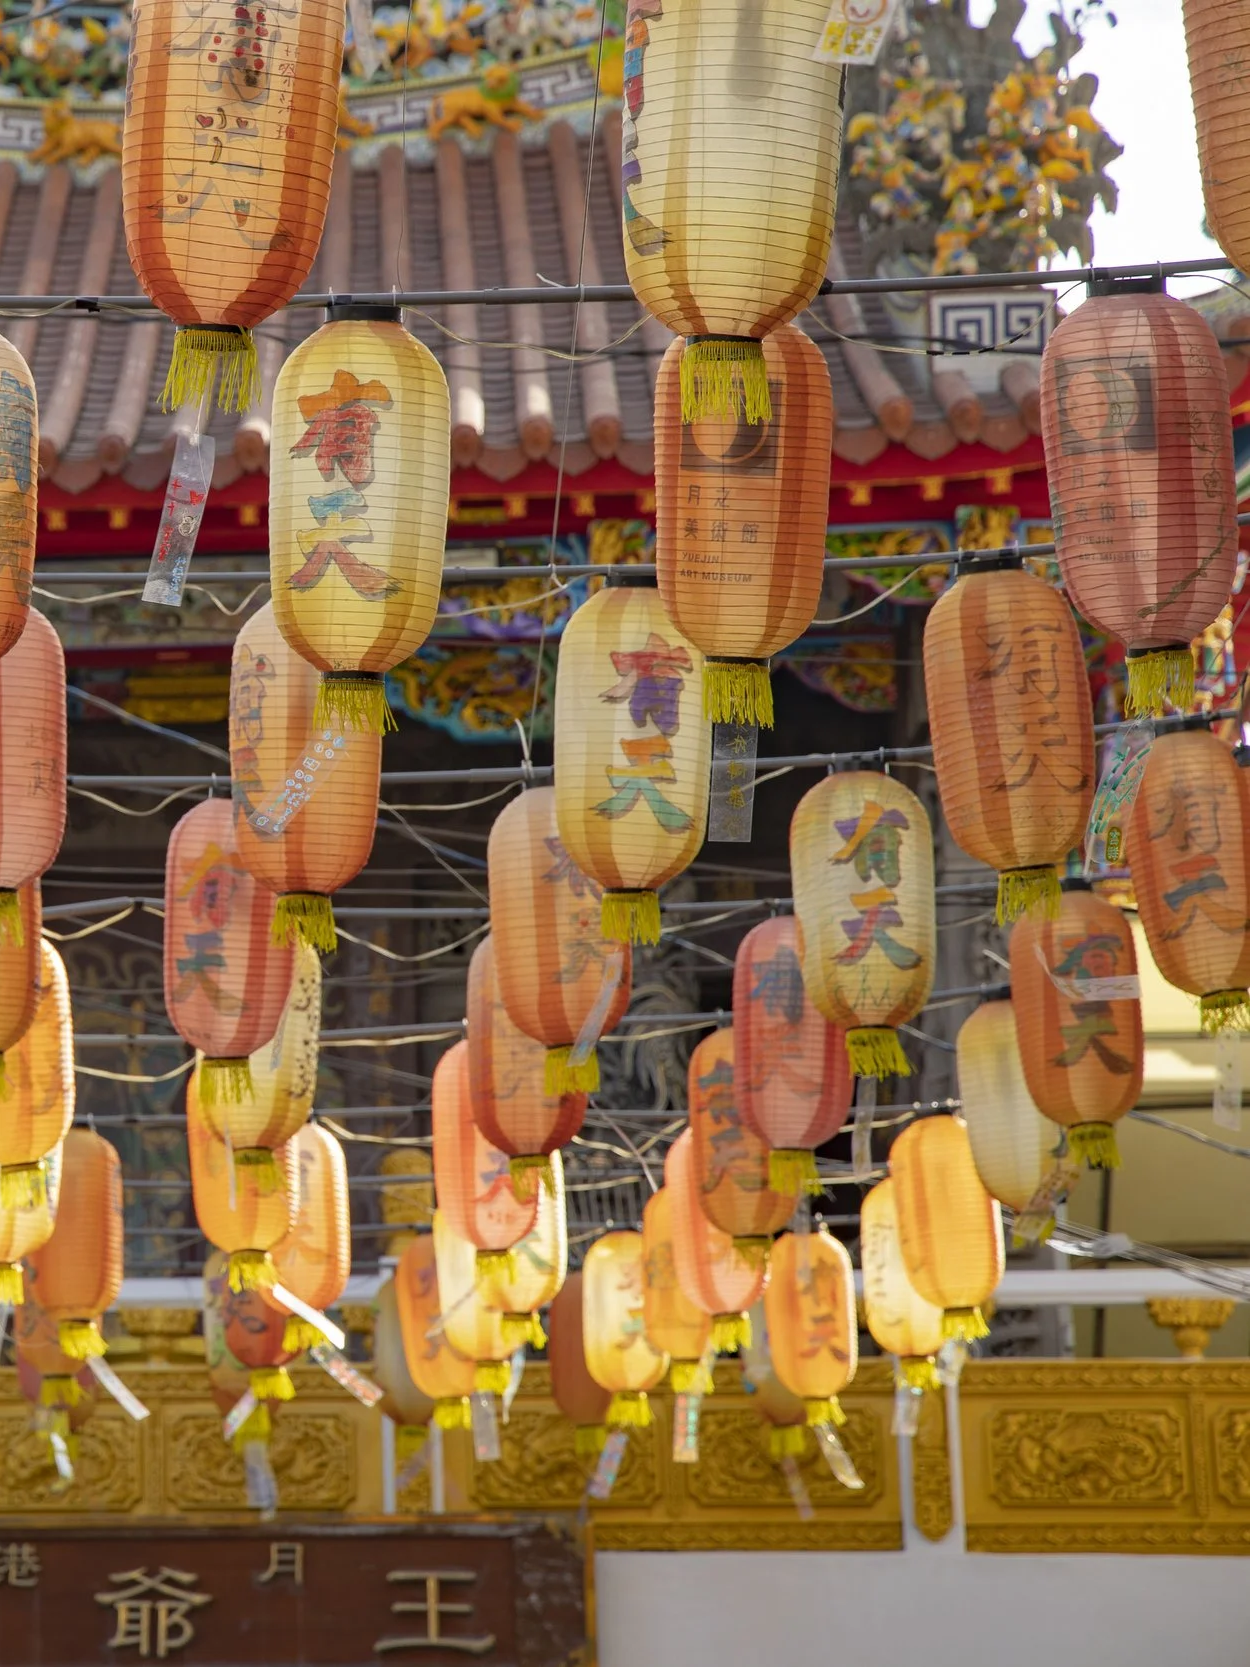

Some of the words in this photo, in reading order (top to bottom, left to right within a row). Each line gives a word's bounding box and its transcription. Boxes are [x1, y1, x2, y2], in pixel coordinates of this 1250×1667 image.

[285, 369, 405, 602] 有天
[681, 551, 720, 564] YUEJIN
[683, 517, 761, 544] 美術館
[687, 484, 731, 509] 月之
[679, 568, 698, 580] ART
[701, 570, 753, 583] MUSEUM
[588, 632, 696, 836] 有天
[975, 599, 1089, 795] 有天
[172, 842, 252, 1018] 有天
[828, 800, 924, 971] 有天
[1150, 770, 1248, 942] 有天
